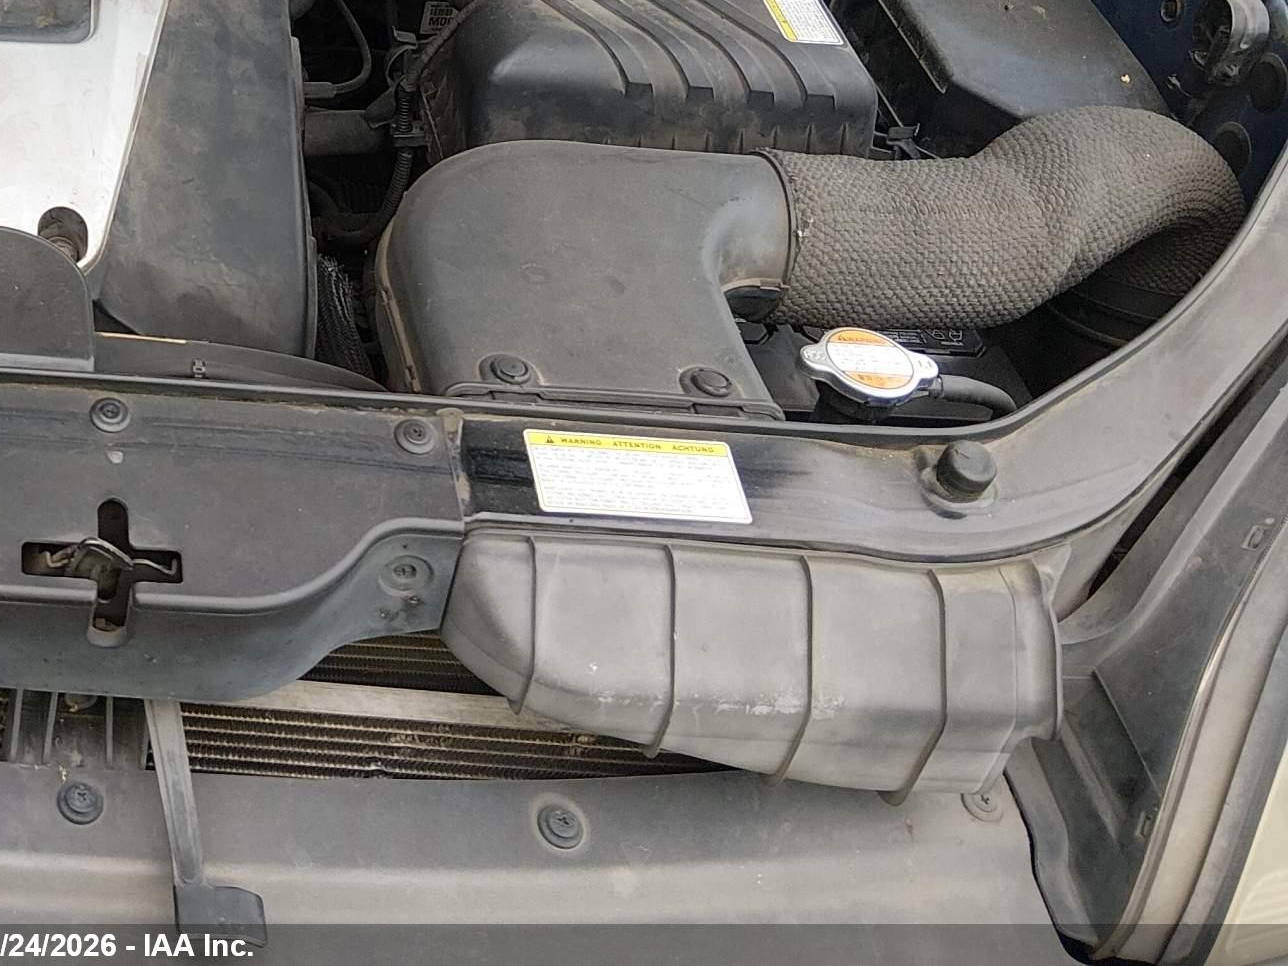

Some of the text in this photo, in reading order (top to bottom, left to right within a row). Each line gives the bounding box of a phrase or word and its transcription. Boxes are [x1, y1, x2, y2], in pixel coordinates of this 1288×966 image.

[560, 437, 714, 453] WARNING ATTENTION ACHTUNG
